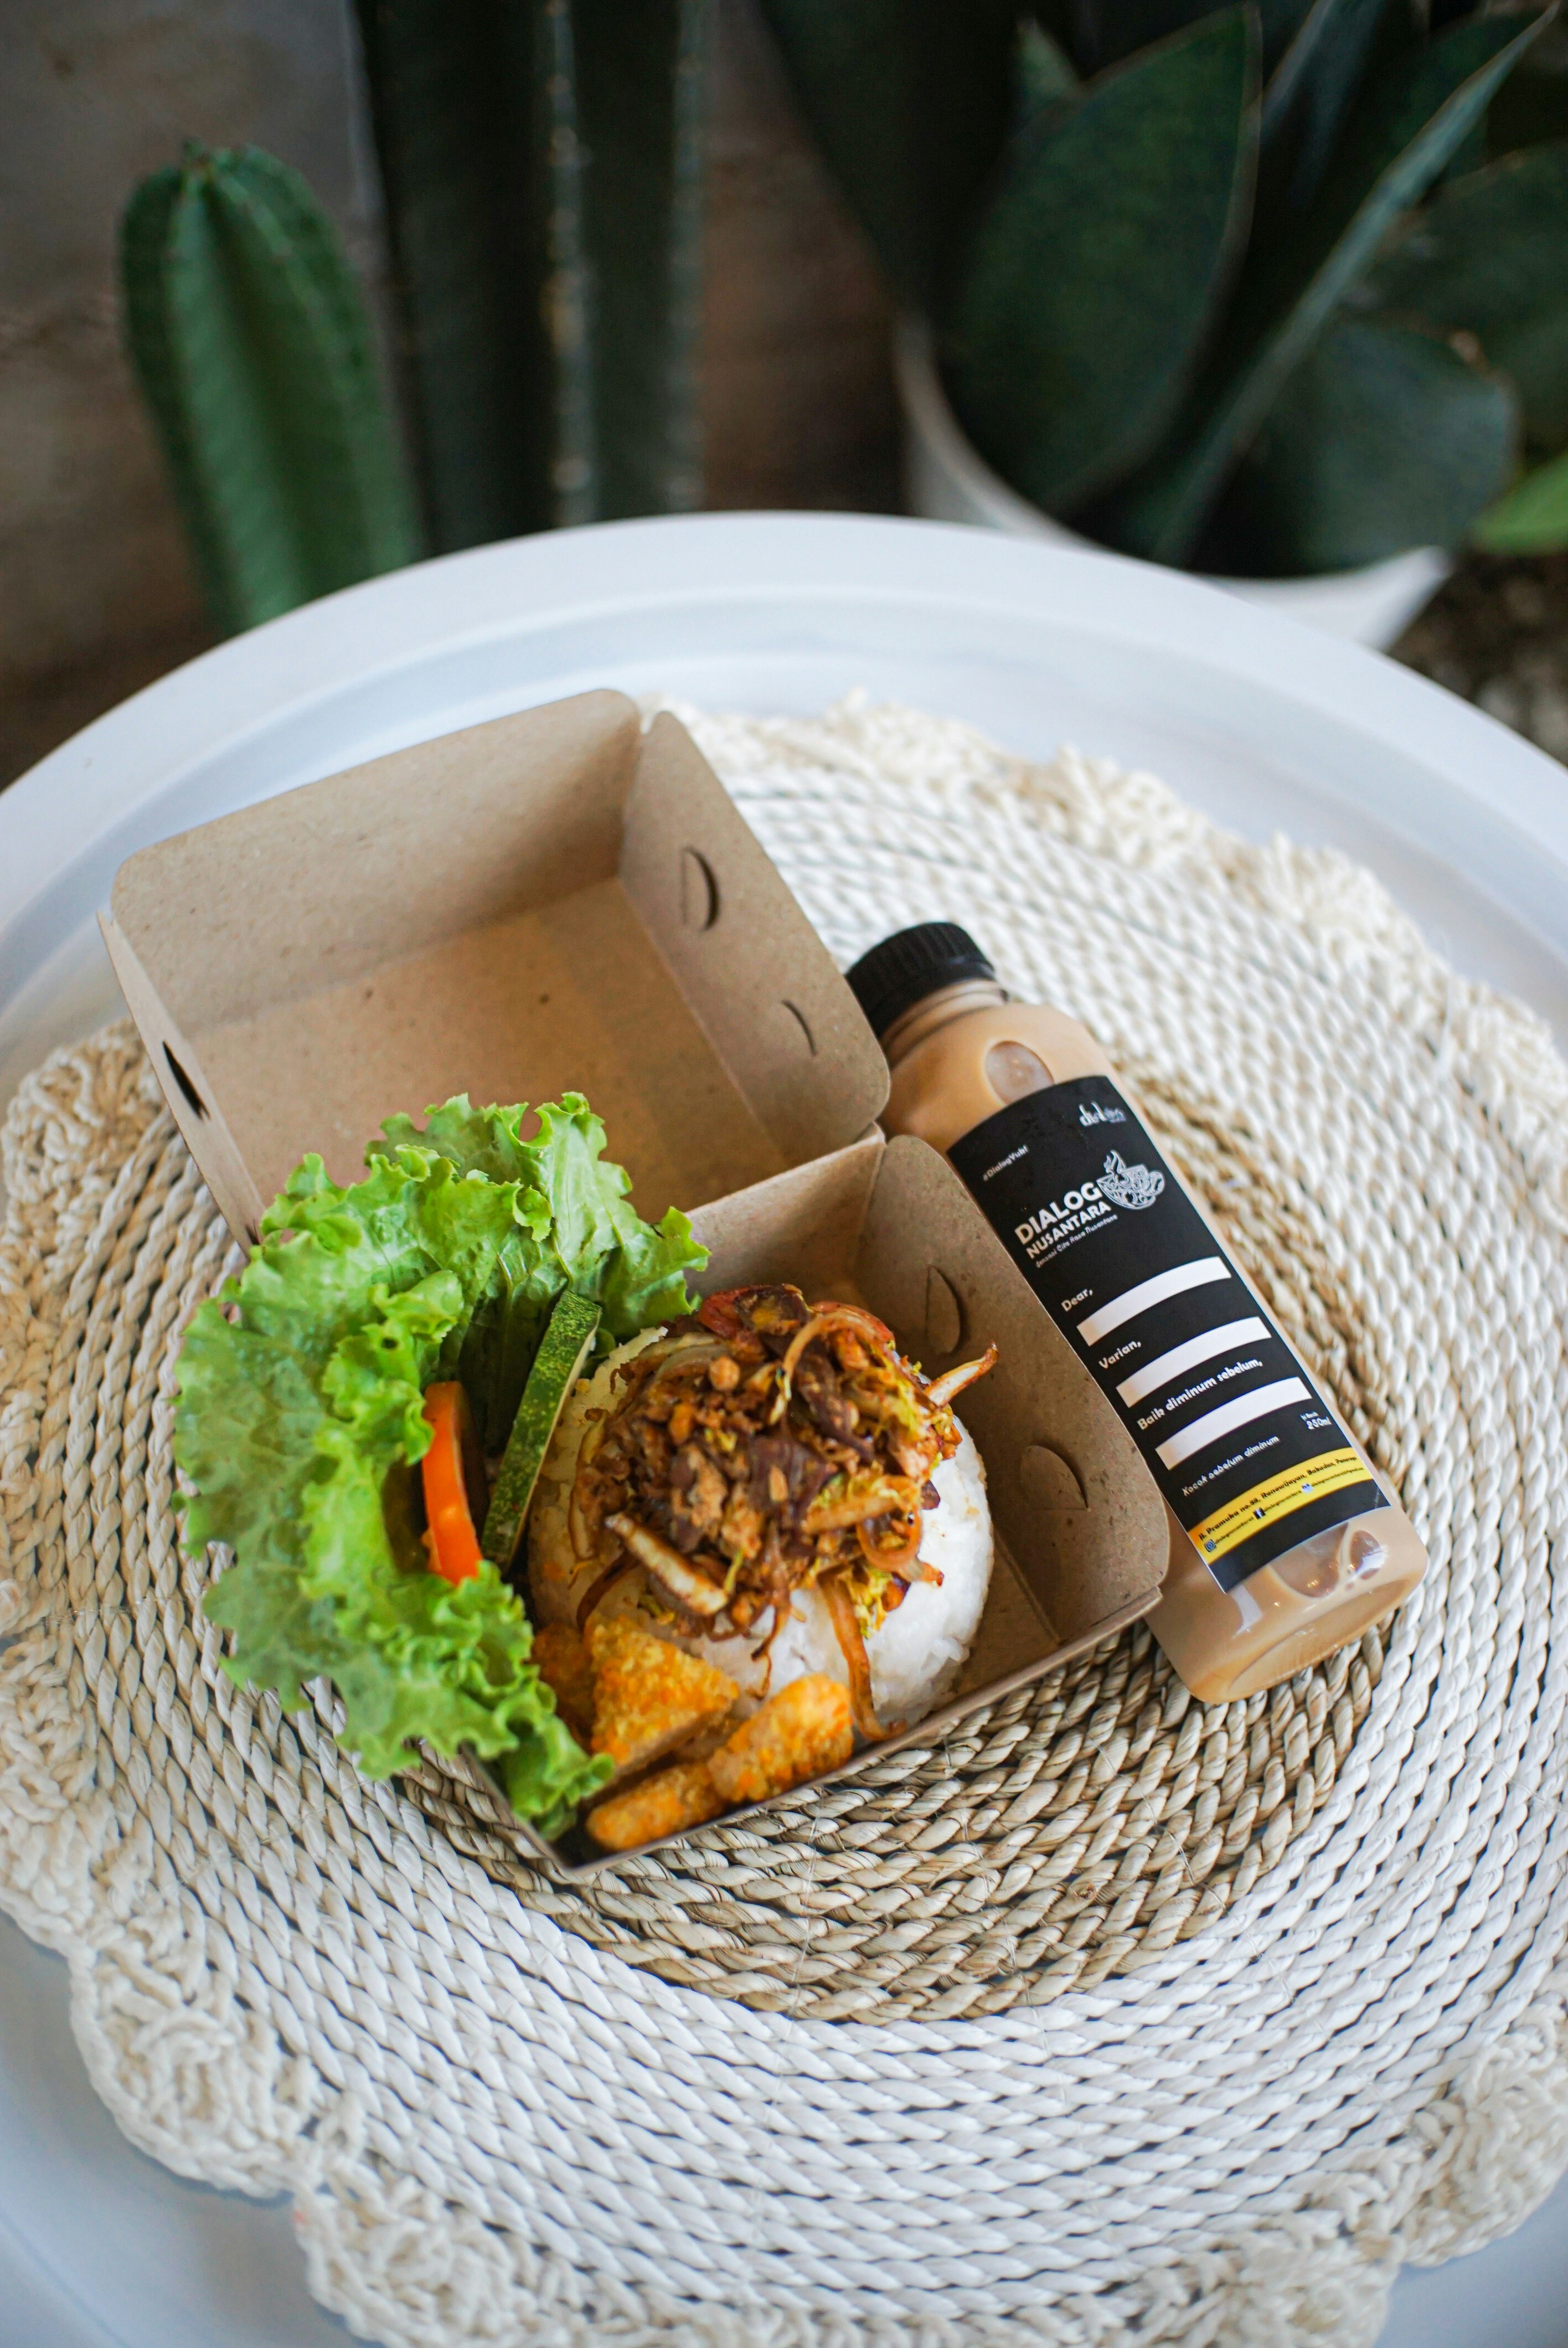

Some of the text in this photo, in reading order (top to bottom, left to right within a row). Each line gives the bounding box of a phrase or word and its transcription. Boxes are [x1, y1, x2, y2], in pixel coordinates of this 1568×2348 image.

[1014, 1182, 1102, 1244] DIALOG
[1026, 1201, 1111, 1259] NUSANTARA
[1061, 1288, 1093, 1312] Dear,
[1098, 1340, 1142, 1369] Varian,
[1137, 1358, 1263, 1430] Baik diminum sebelum,
[1182, 1435, 1280, 1497] Kocok sebelum diminum
[1206, 1511, 1239, 1535] Pramuka
